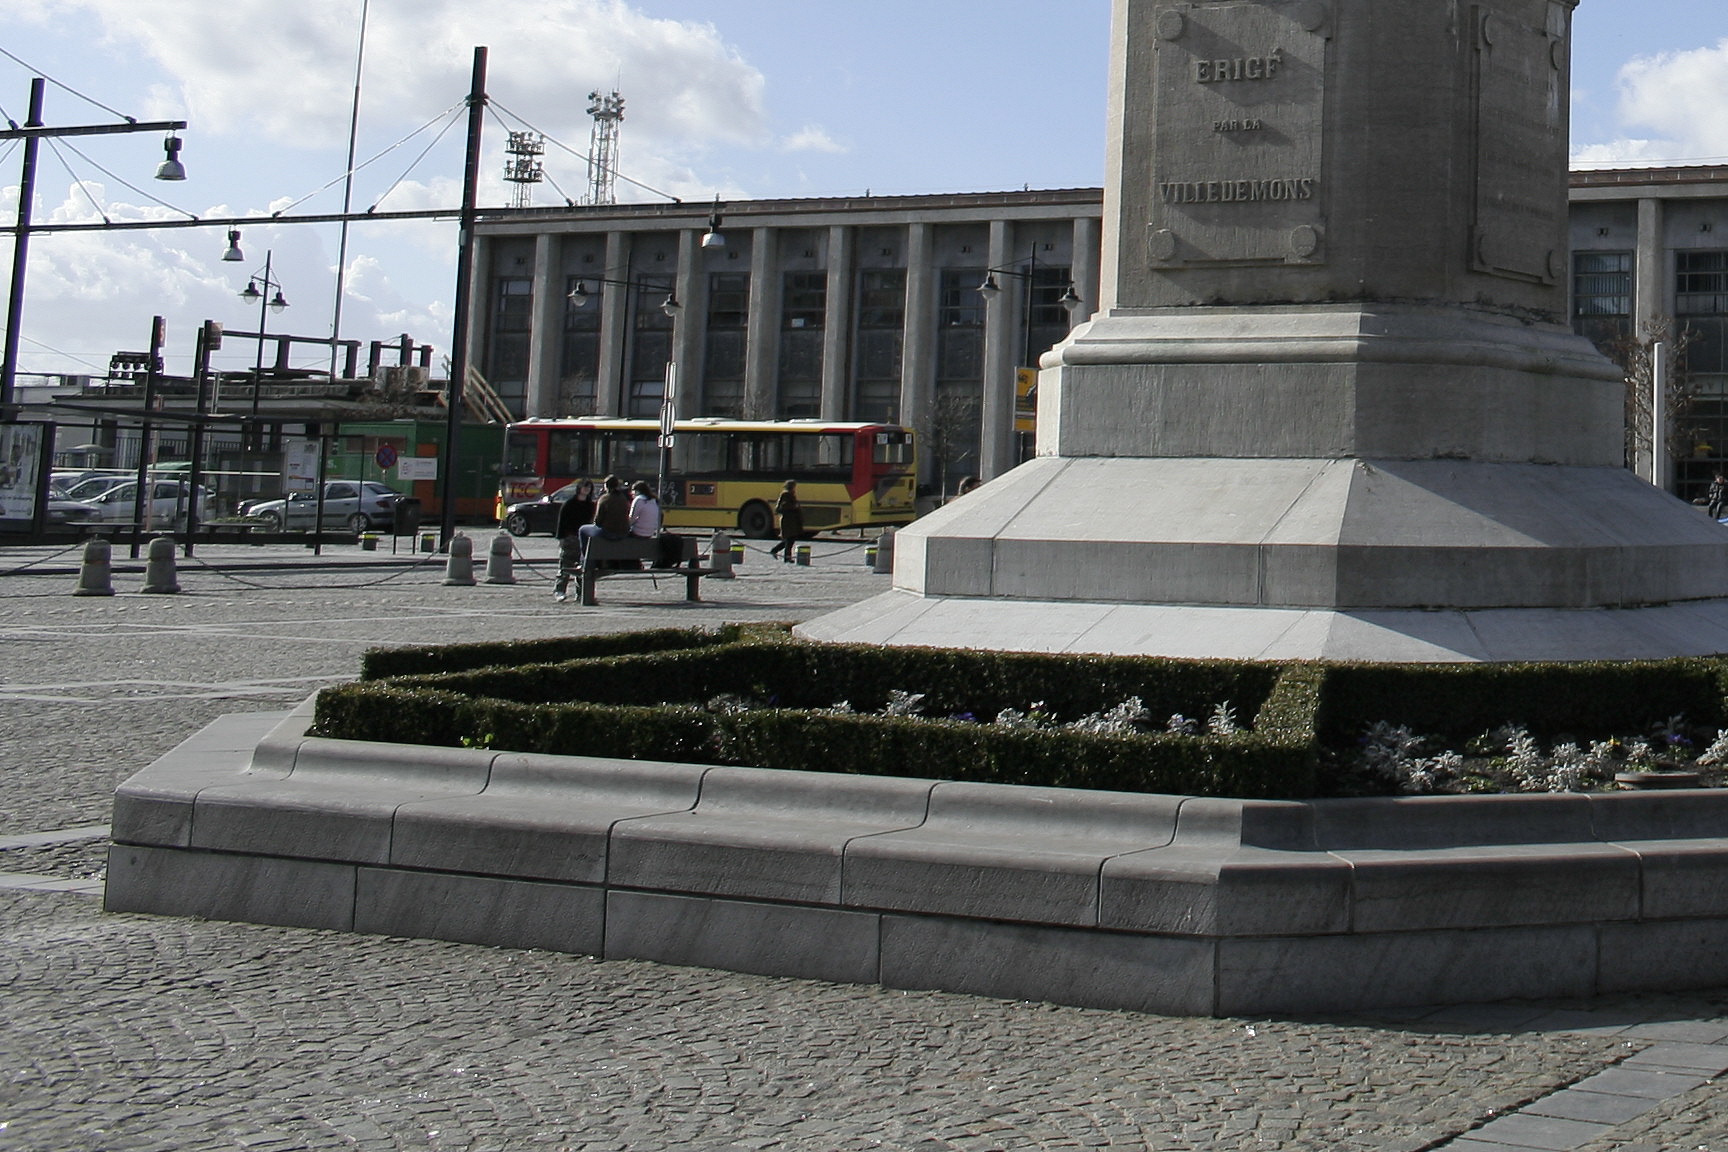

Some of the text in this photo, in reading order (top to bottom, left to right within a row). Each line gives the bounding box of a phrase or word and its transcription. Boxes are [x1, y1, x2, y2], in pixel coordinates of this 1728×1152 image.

[1212, 118, 1262, 133] PAR LA
[1158, 177, 1313, 204] VILLE DE MONS
